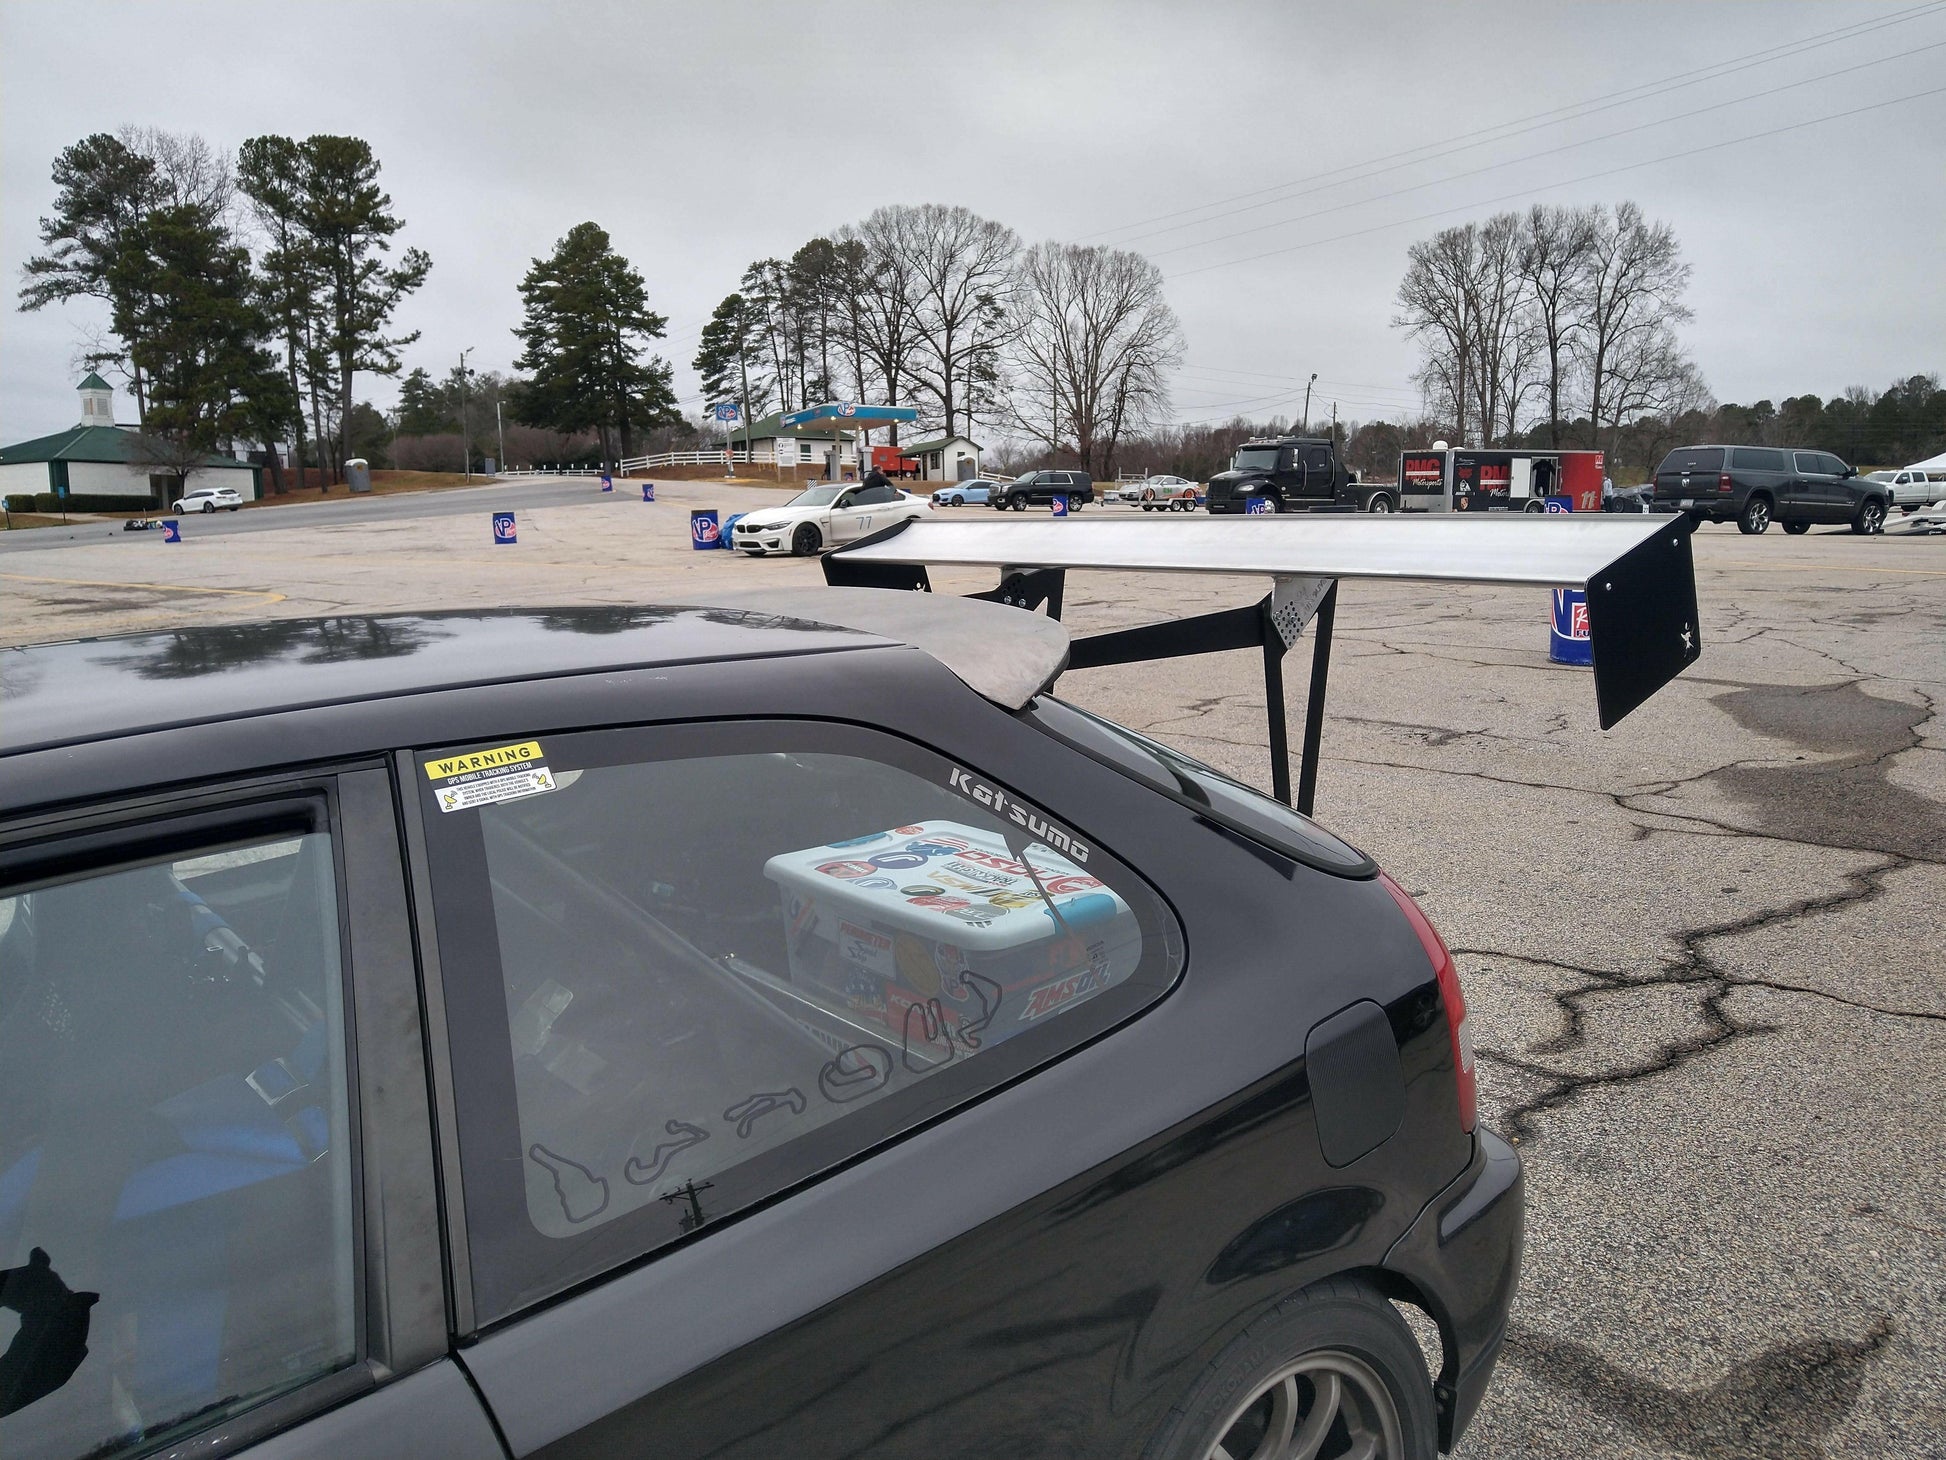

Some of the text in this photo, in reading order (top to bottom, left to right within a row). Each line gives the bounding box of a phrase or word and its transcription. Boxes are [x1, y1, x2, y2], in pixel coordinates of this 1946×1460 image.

[856, 516, 872, 530] 77
[438, 747, 531, 774] WARNING
[447, 761, 533, 785] GPS MOBILE TRACKING SYSTEM
[949, 767, 1089, 863] Katsumo
